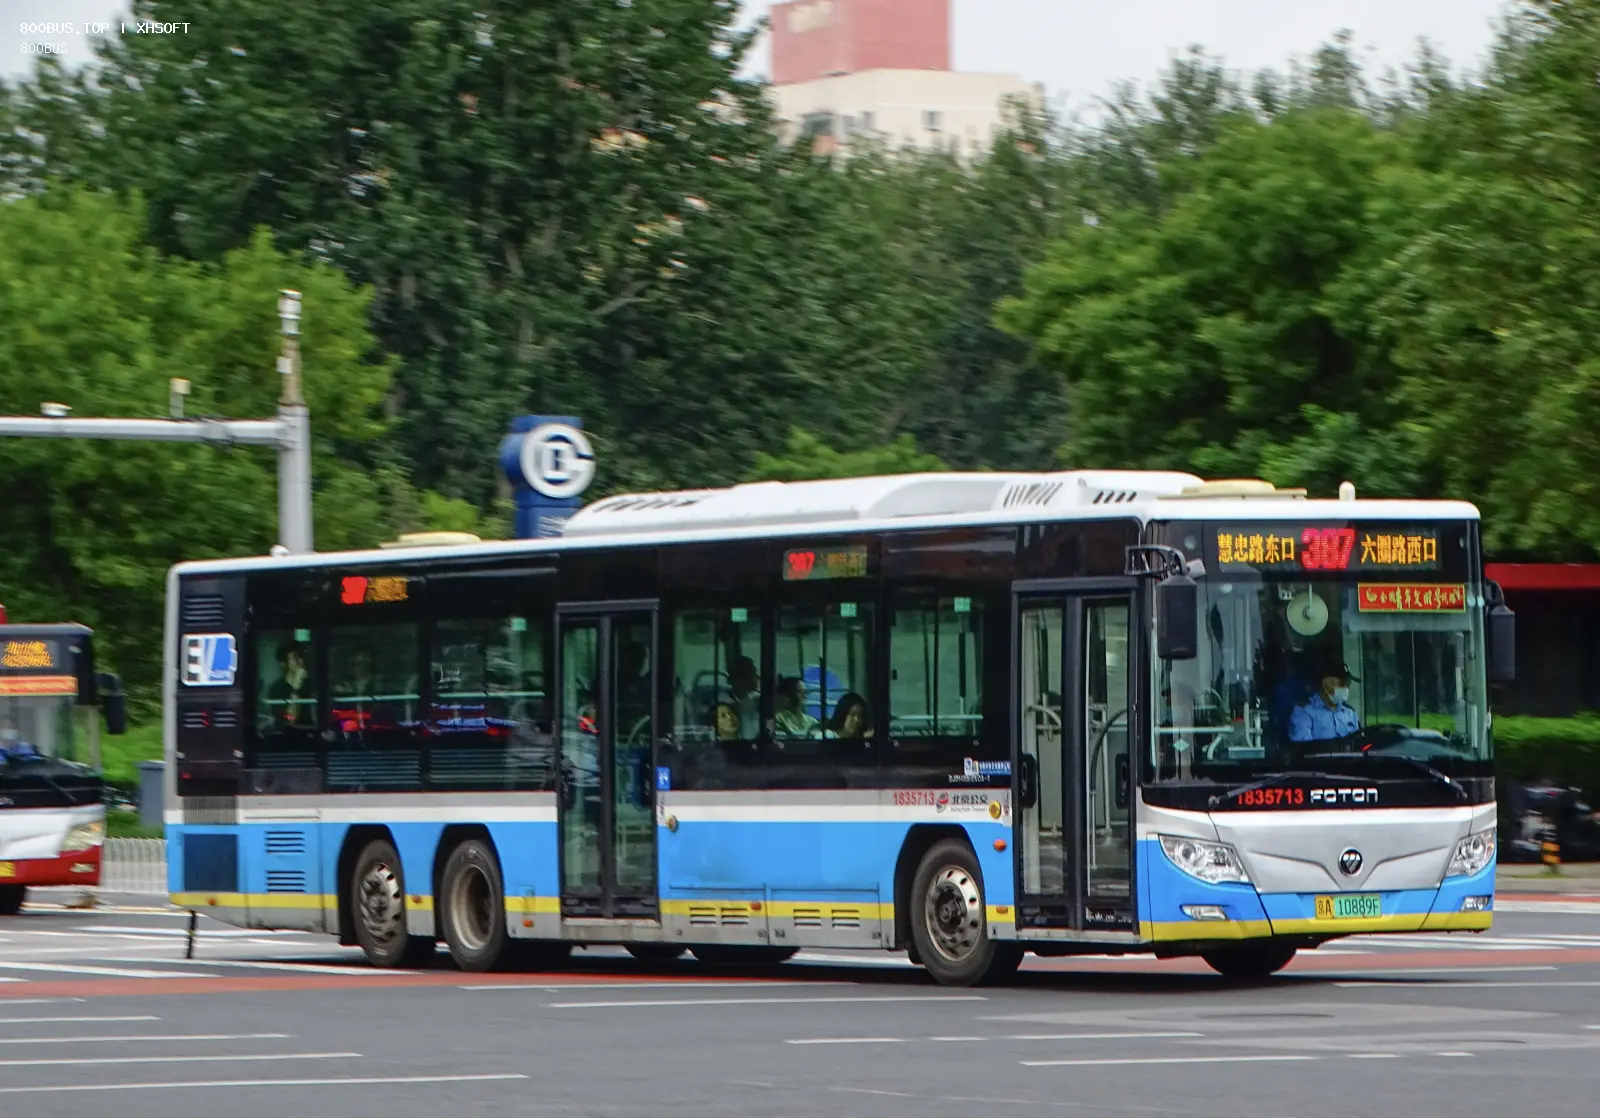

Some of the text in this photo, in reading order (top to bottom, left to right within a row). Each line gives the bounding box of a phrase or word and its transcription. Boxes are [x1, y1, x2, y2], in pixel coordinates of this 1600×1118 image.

[1217, 533, 1296, 564] 慧忠路东口
[893, 791, 935, 806] 1835713
[1310, 787, 1379, 804] FOTON
